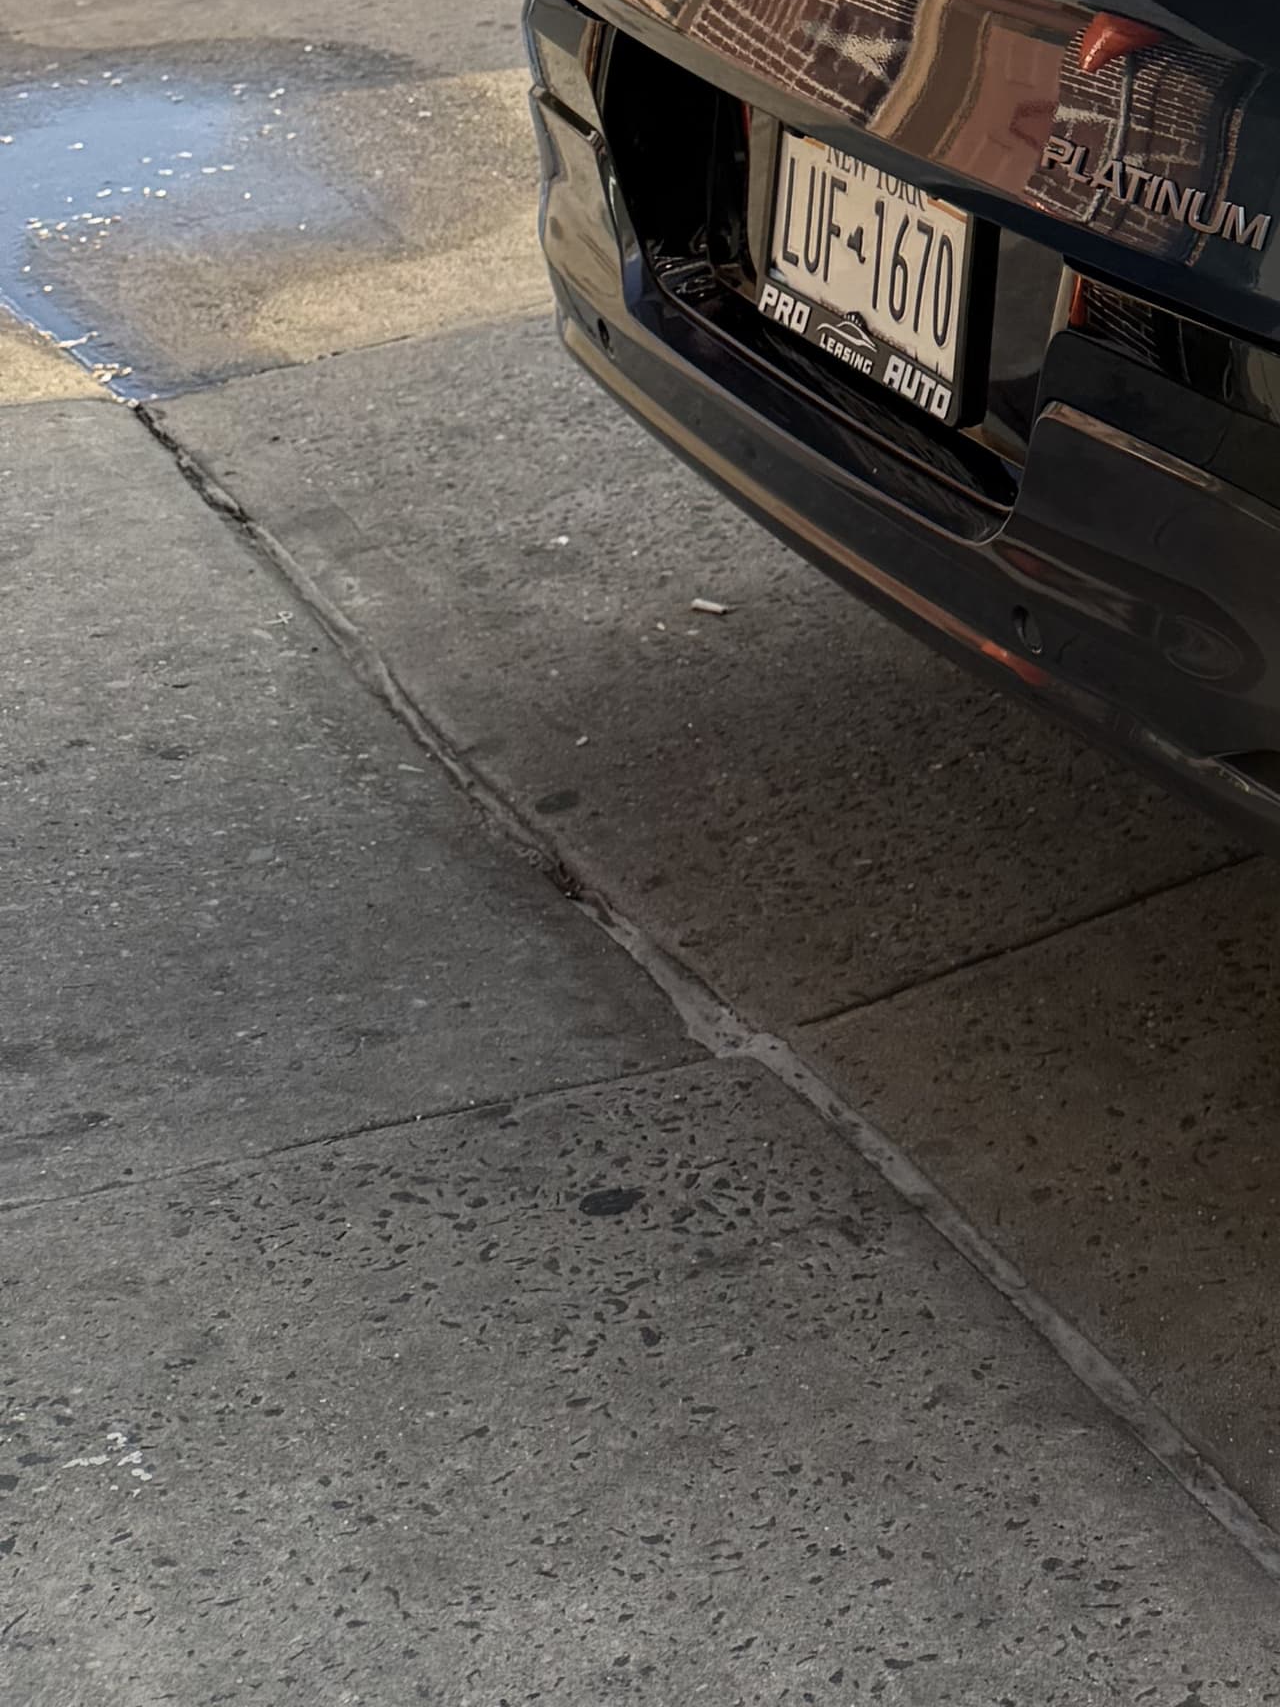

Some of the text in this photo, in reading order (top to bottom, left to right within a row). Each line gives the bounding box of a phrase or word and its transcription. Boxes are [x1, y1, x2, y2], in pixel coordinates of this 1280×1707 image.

[1041, 134, 1273, 253] PLATINUM
[757, 282, 812, 336] PRO
[819, 331, 874, 377] LEASING
[881, 353, 953, 421] AUTO
